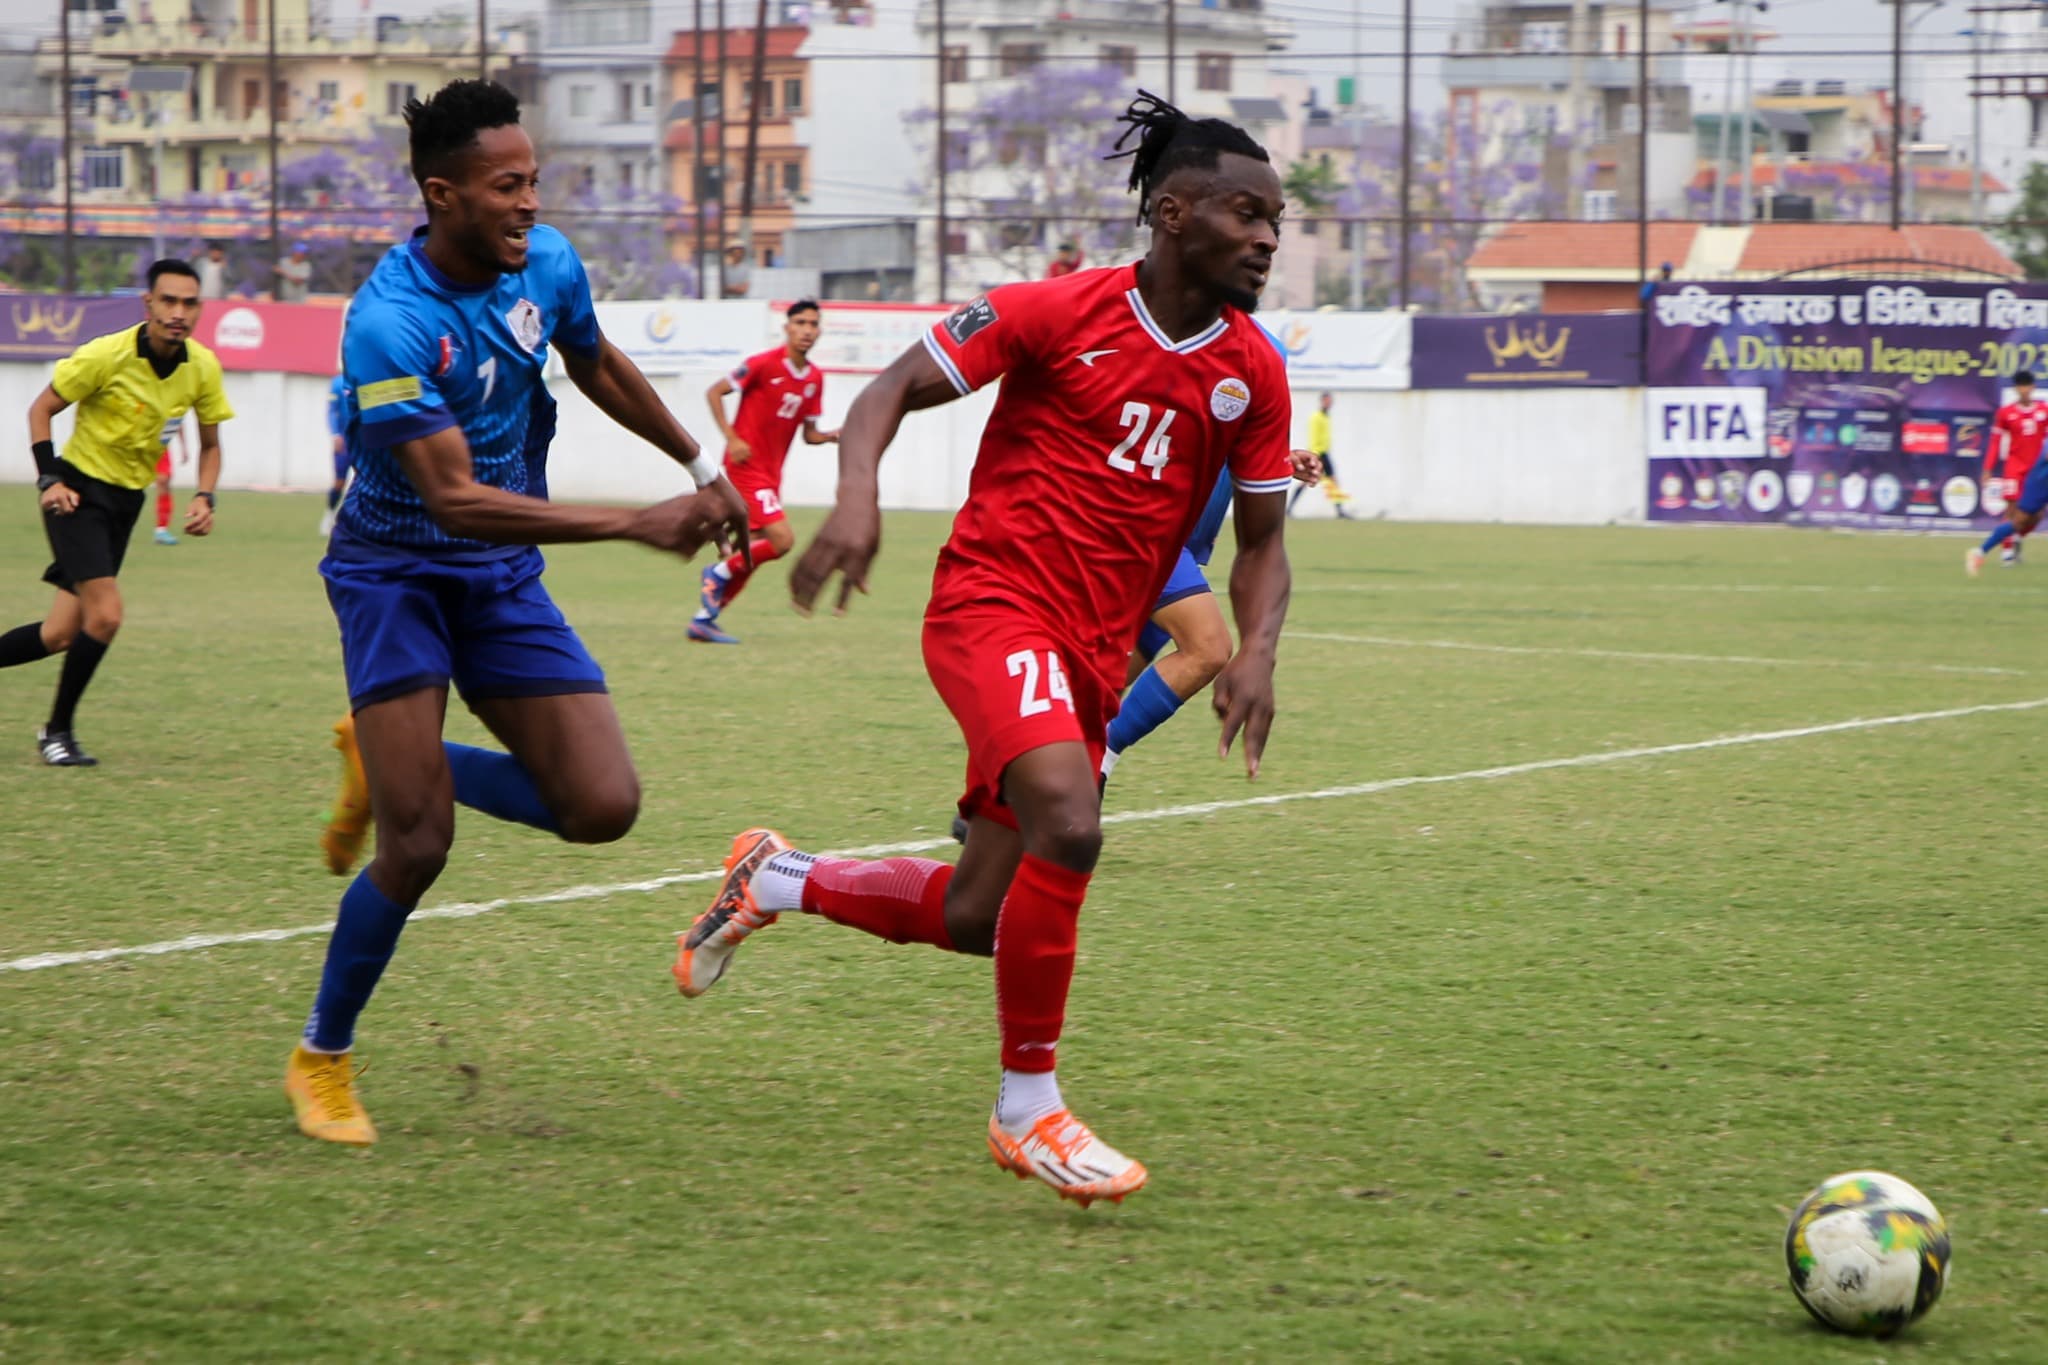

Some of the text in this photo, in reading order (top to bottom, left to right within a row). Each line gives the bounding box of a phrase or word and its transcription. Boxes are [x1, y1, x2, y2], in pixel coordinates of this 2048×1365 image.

[1702, 336, 1730, 371] A
[1736, 335, 1862, 373] Division
[1107, 401, 1176, 480] 24
[1662, 404, 1752, 441] FIFA
[1006, 649, 1075, 718] 24
